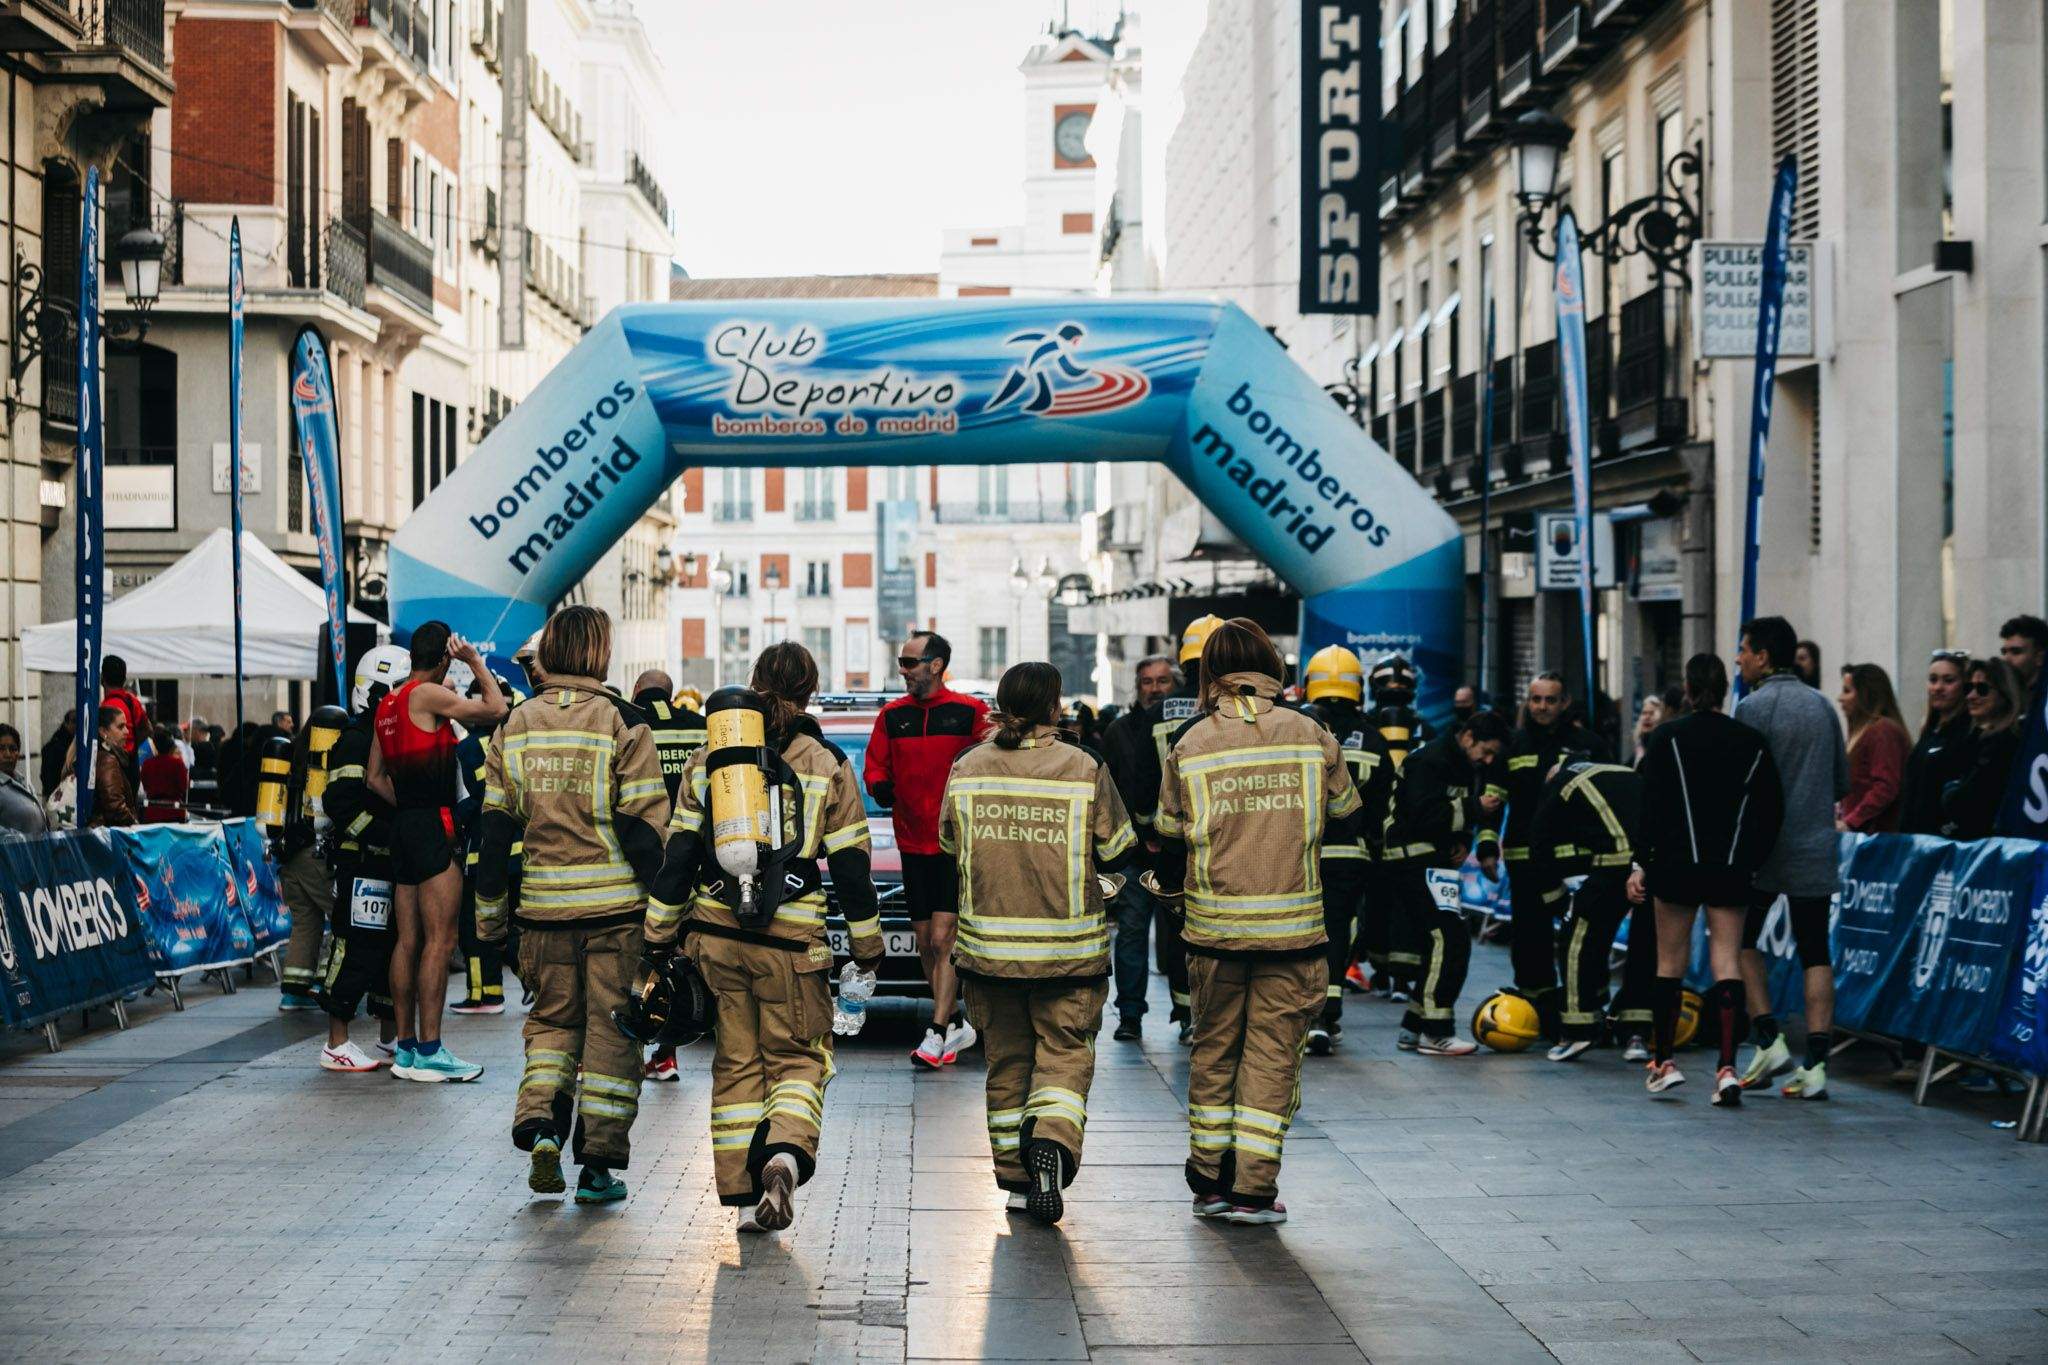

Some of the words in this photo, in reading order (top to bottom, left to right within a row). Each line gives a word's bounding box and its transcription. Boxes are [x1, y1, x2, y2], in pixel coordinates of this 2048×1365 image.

[715, 326, 816, 358] Club
[735, 359, 954, 416] Deportivo
[715, 415, 825, 434] bomberos
[838, 415, 867, 433] de
[879, 414, 956, 433] madrid
[468, 379, 636, 540] bomberos
[1225, 381, 1391, 547] bomberos
[507, 434, 642, 575] madrid
[1192, 423, 1336, 555] madrid
[523, 756, 594, 775] OMBERS
[975, 803, 1068, 823] BOMBERS
[973, 821, 1068, 845] VALÈNCIA
[890, 935, 919, 953] CJ
